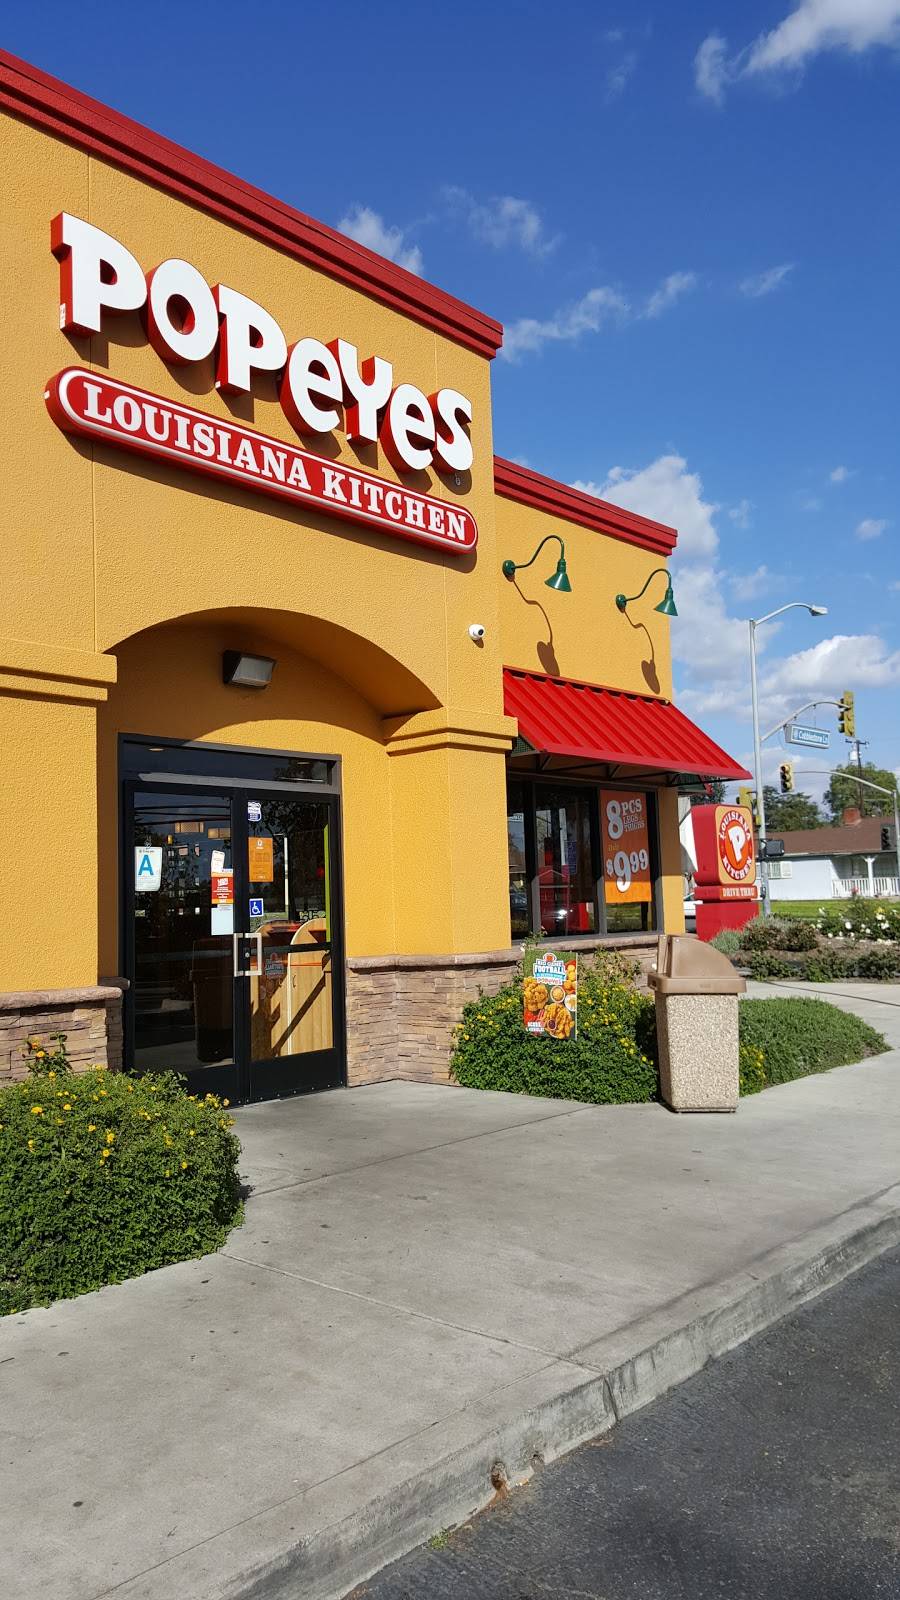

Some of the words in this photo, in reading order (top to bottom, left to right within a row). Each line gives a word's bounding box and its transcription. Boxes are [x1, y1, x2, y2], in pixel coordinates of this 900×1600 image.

[83, 381, 312, 490] LOUISIANA
[322, 466, 467, 542] KITCHEN
[606, 800, 624, 840] 8
[621, 798, 642, 815] PCS
[720, 811, 751, 841] LOUISIANA
[728, 825, 746, 862] P
[138, 854, 154, 876] A
[723, 855, 753, 880] KITCHEN
[722, 887, 740, 897] DRIVE
[534, 965, 564, 974] FOOTBALL
